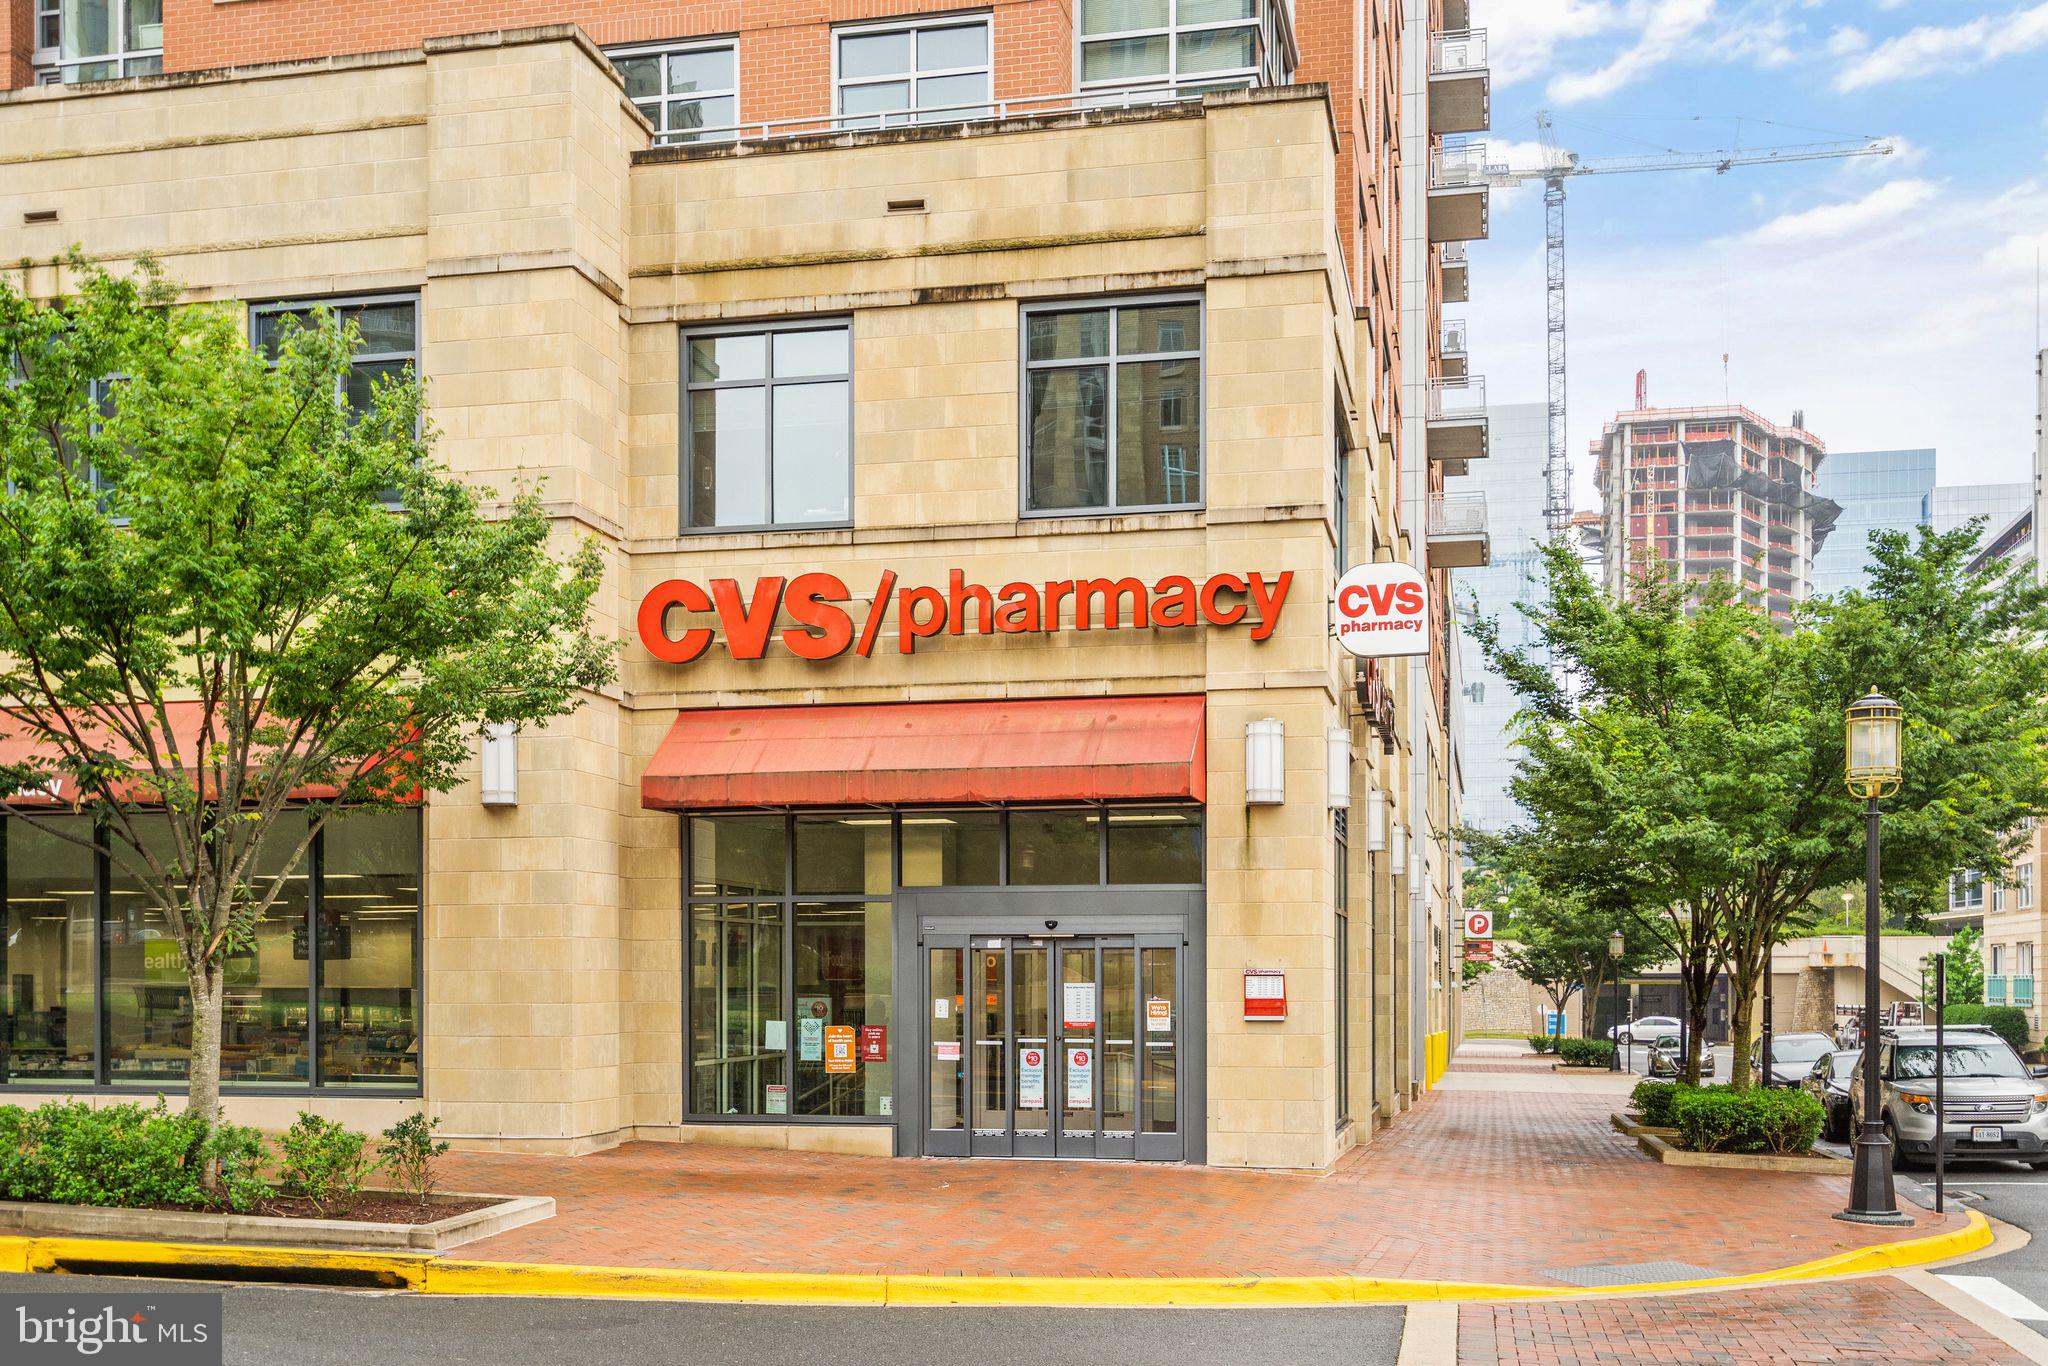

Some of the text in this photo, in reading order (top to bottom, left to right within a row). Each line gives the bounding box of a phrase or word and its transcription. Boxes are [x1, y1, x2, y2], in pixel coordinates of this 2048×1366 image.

[1338, 581, 1425, 618] CVS
[1340, 619, 1423, 636] pharmacy
[1474, 917, 1485, 931] P
